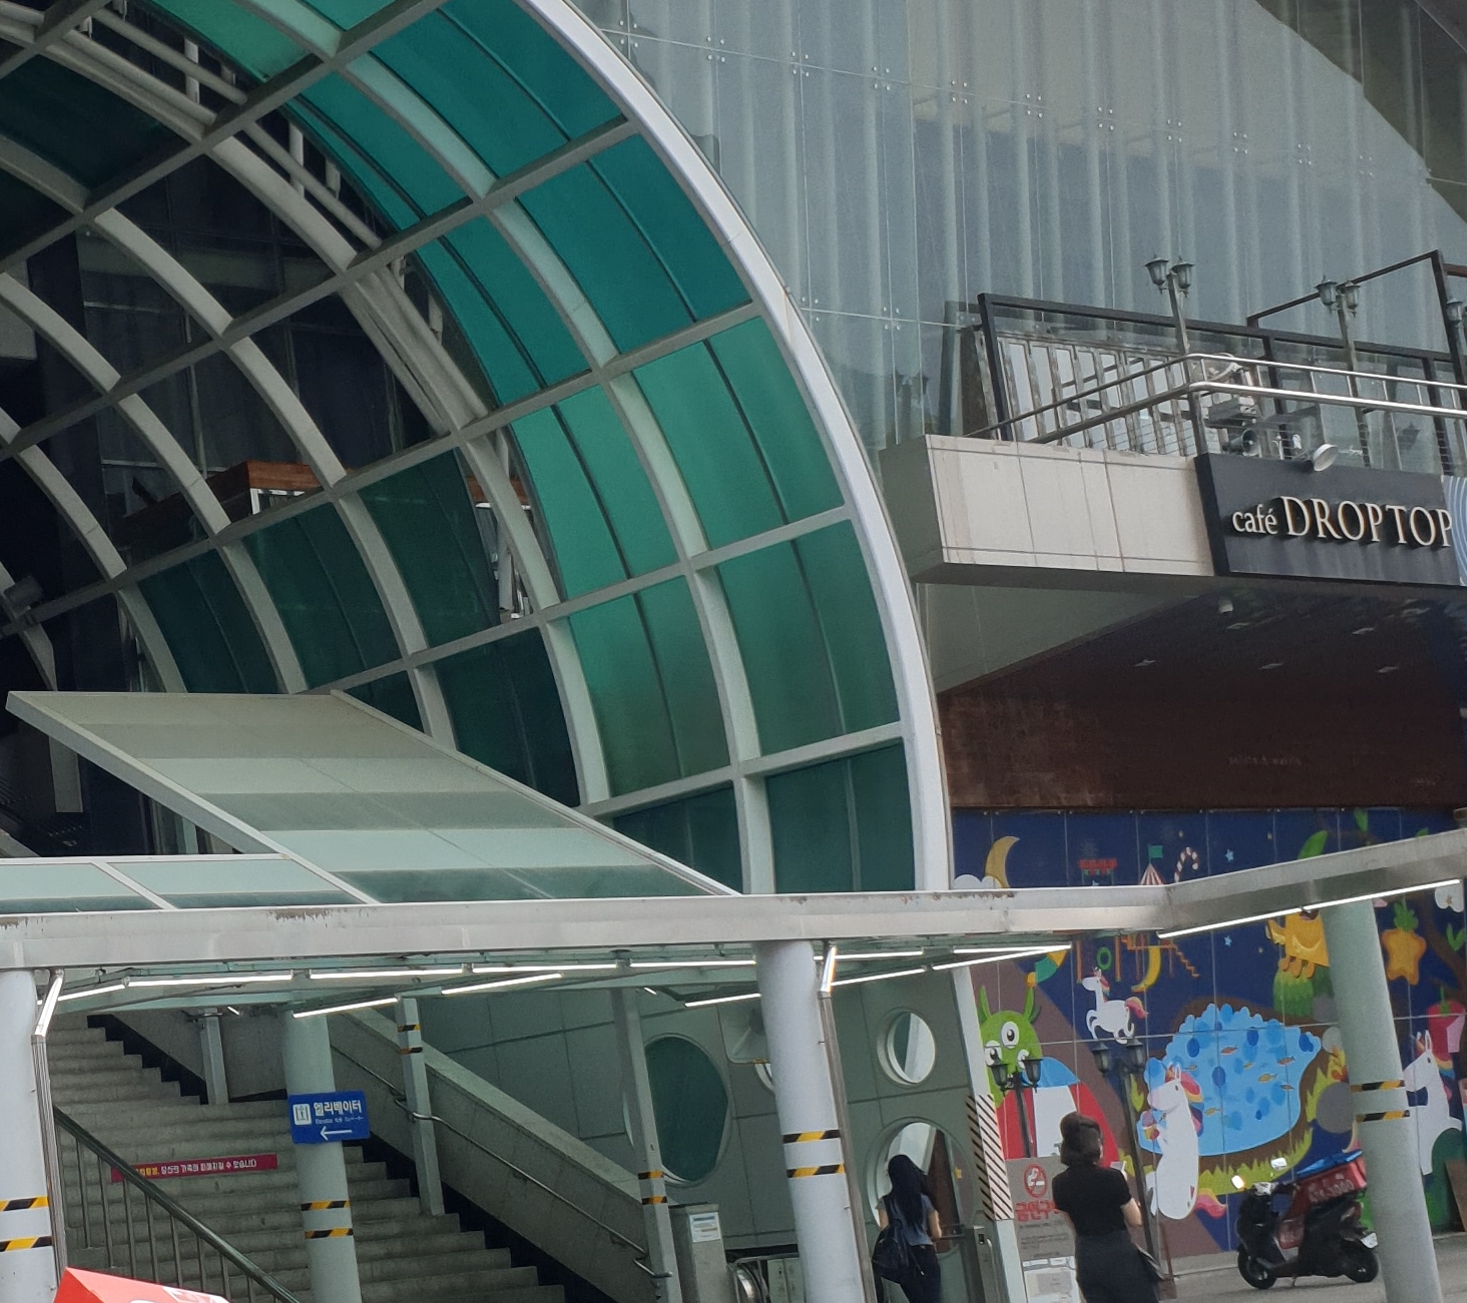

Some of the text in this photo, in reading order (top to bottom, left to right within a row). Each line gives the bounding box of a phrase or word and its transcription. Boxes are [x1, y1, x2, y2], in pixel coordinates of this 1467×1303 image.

[1232, 496, 1453, 547] café DROPTOP
[313, 1099, 363, 1117] 엘리베이터
